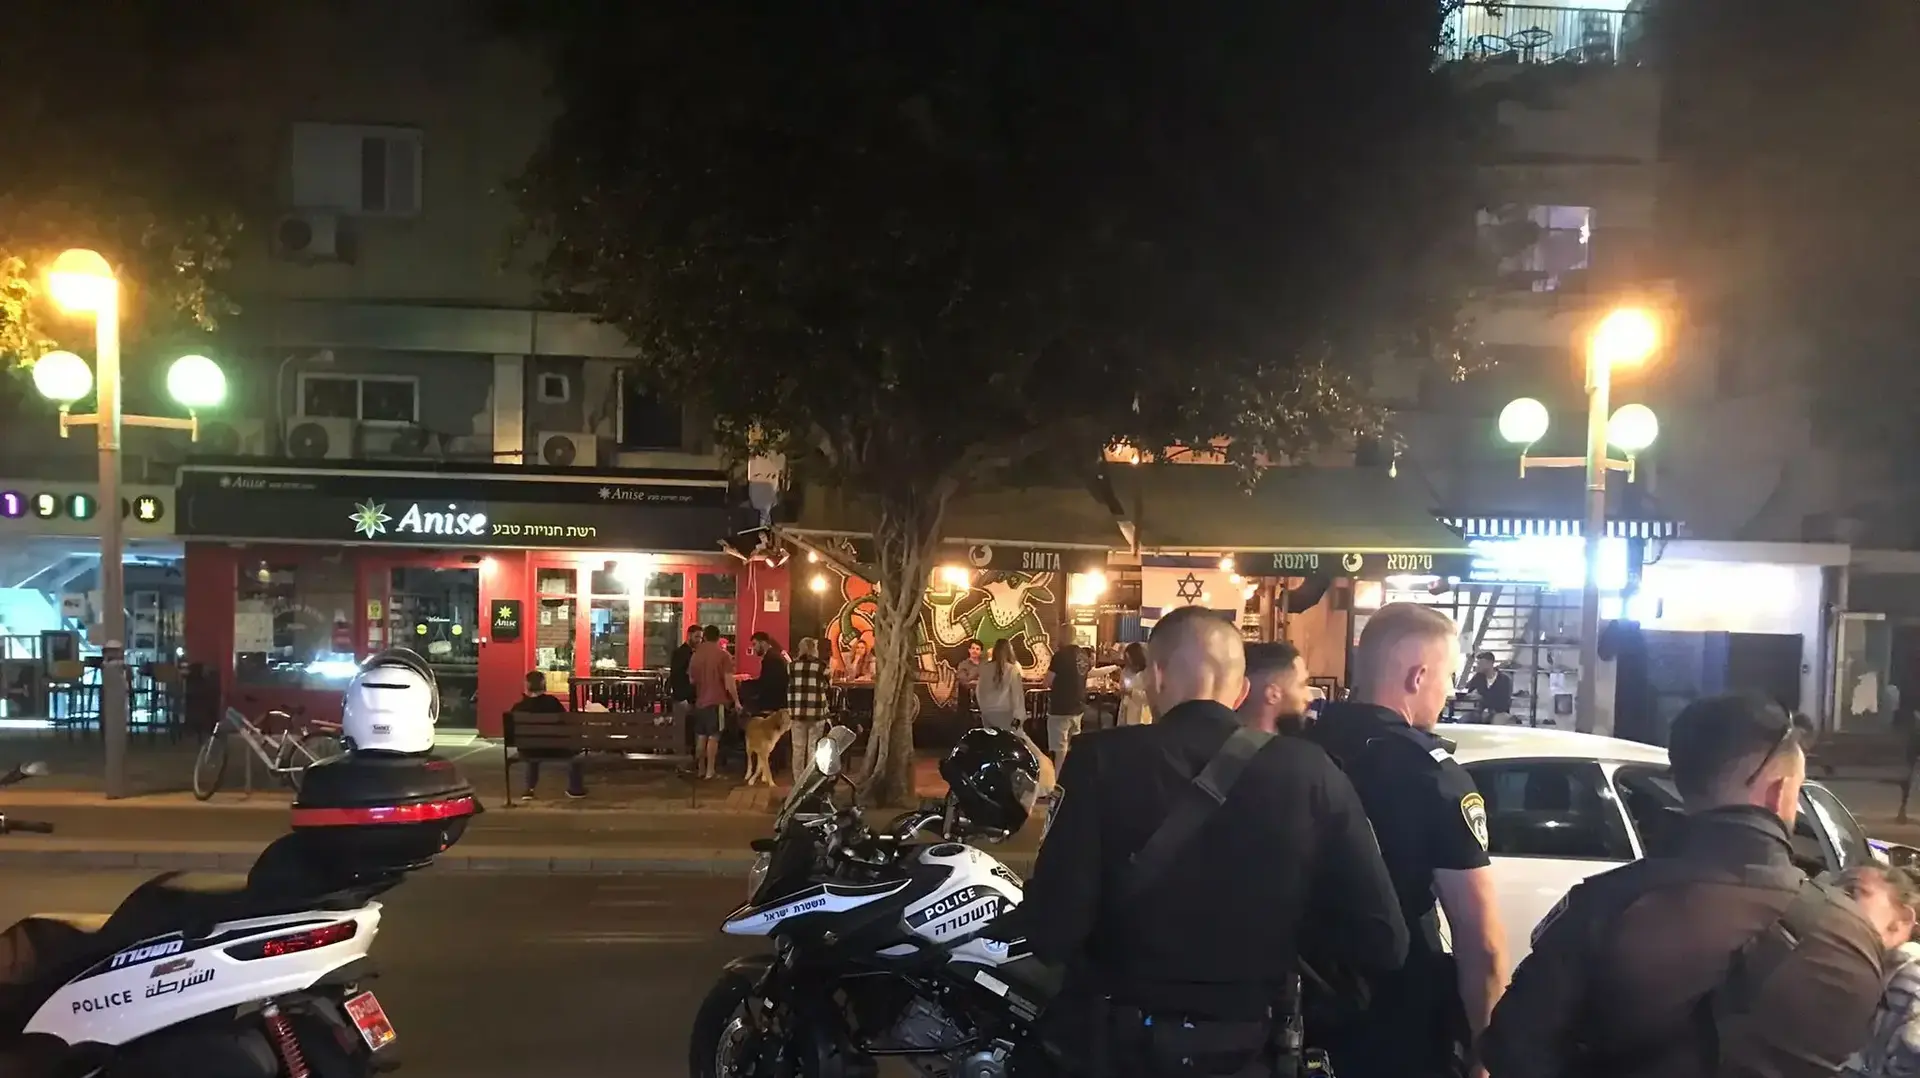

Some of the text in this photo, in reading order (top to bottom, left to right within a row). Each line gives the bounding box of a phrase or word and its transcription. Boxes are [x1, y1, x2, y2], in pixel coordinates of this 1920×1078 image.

[611, 487, 645, 501] Anise
[395, 503, 487, 536] Anise
[492, 523, 597, 538] רשת חנויות טבע
[1022, 551, 1061, 570] SIMTA
[763, 897, 827, 922] משטרת ישראל
[924, 887, 977, 921] POLICE
[145, 968, 216, 998] الشرطة
[71, 989, 133, 1014] POLICE
